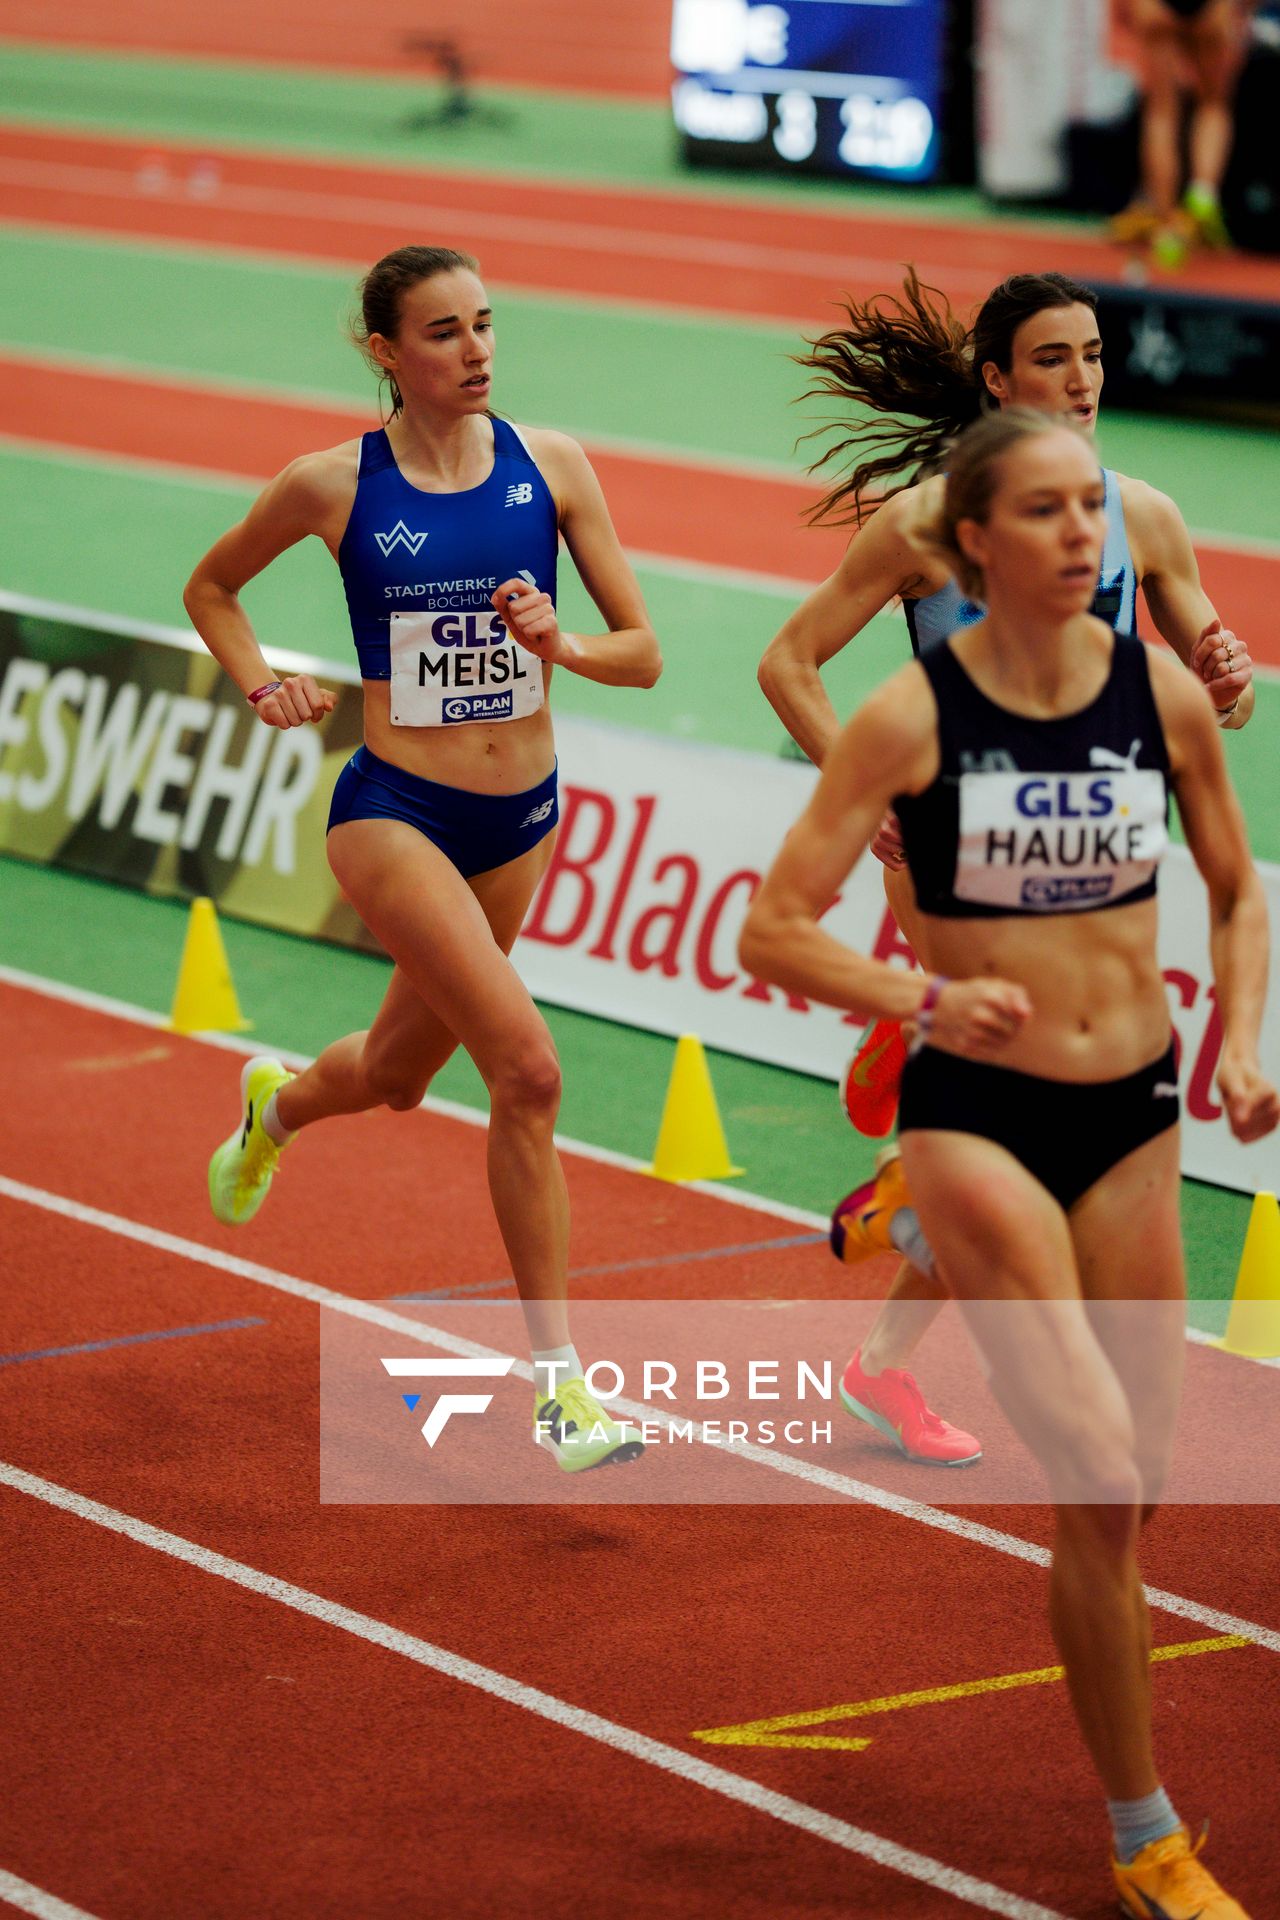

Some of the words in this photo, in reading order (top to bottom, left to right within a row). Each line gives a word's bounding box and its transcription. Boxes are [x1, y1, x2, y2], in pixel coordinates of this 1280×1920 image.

[384, 576, 497, 598] STADTWERKE
[418, 646, 527, 688] MEISL
[473, 696, 511, 712] PLAN
